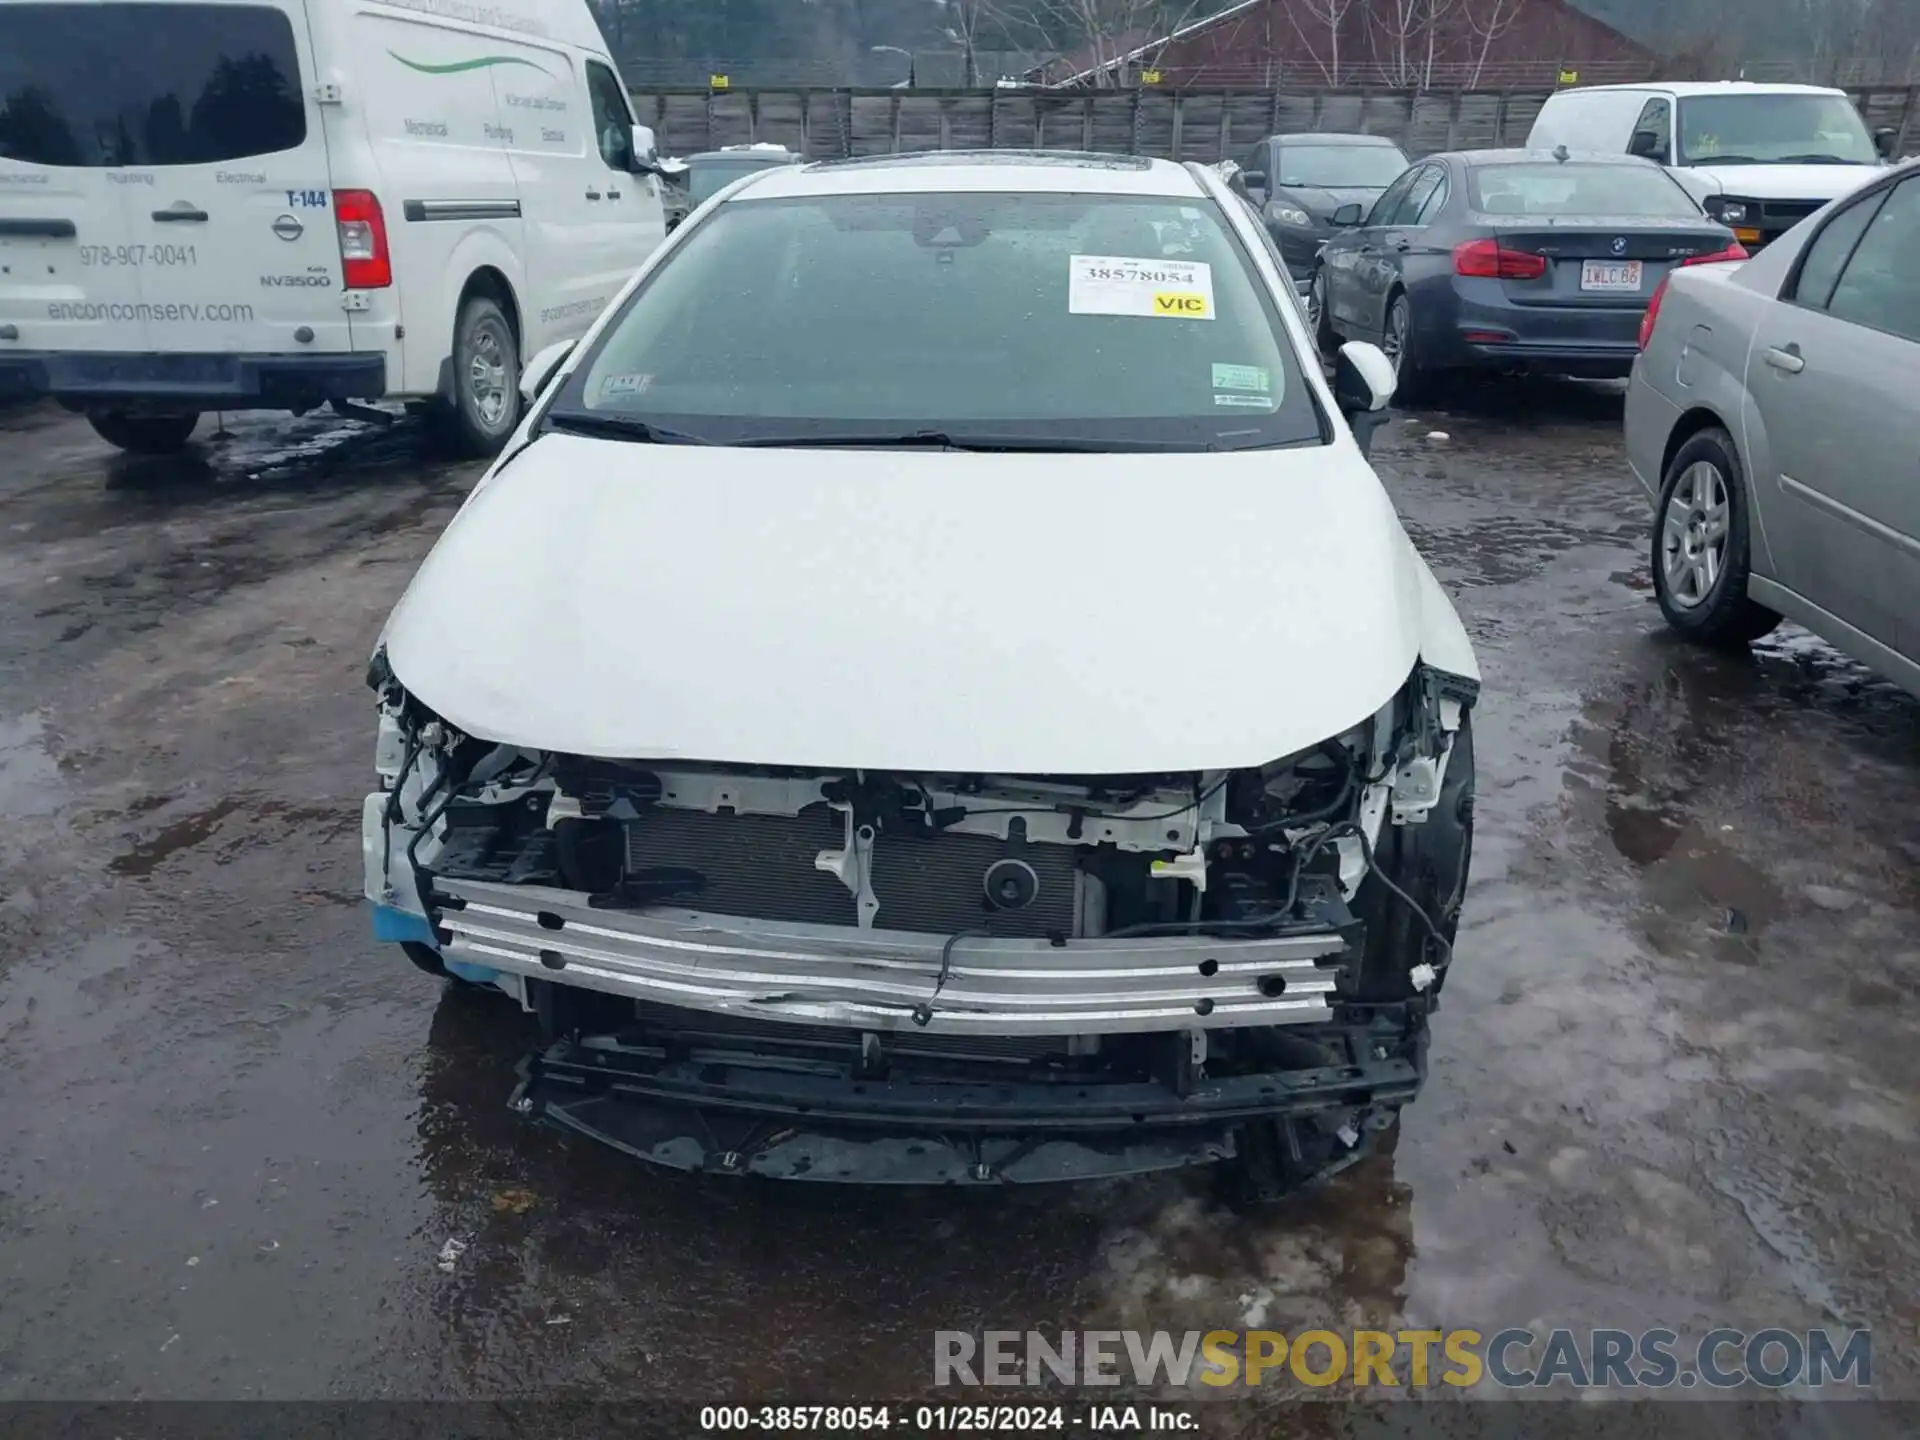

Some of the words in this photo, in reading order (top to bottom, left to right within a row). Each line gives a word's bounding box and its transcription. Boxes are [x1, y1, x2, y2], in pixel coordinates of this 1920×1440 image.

[285, 190, 328, 208] T-144
[260, 275, 331, 288] NV3500
[1086, 267, 1195, 284] 38578054
[48, 302, 254, 323] enconcomserv.com
[1156, 296, 1204, 312] VIC
